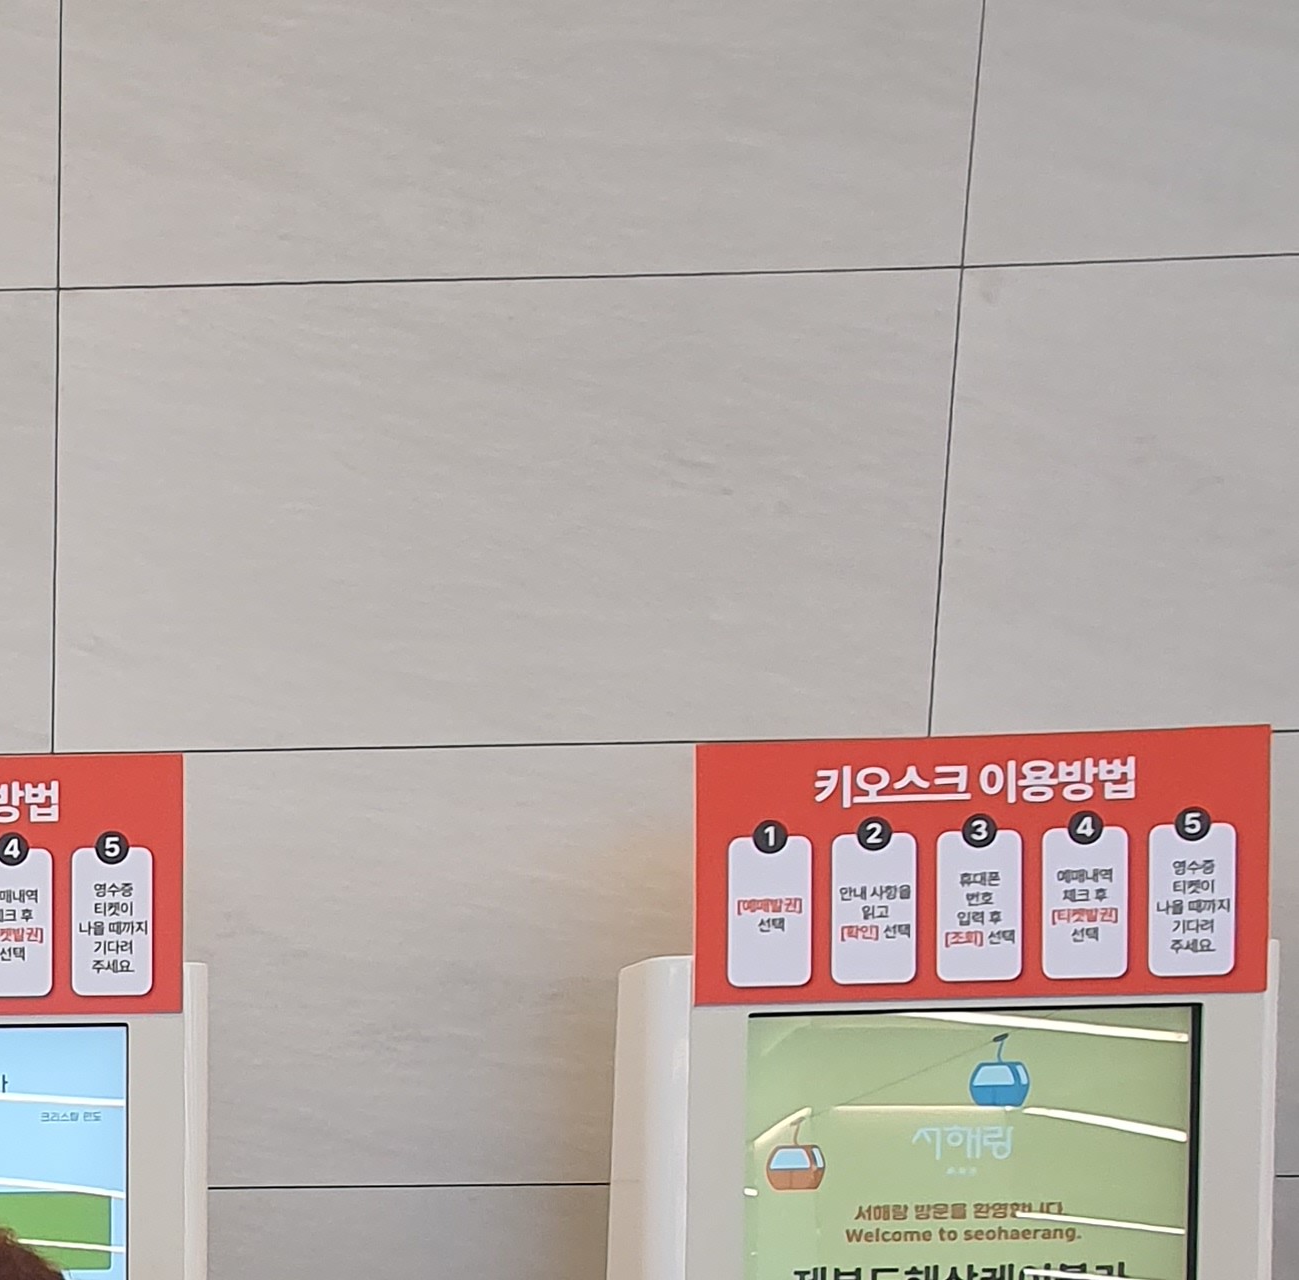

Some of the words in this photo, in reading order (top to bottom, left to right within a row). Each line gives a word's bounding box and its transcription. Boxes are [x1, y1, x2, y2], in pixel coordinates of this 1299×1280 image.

[813, 765, 972, 809] 키오스크
[978, 755, 1137, 804] 이용방법
[1172, 859, 1215, 876] 영수증
[93, 883, 134, 898] 영수증
[839, 885, 866, 901] 안내
[1062, 888, 1091, 902] 체크
[1094, 887, 1108, 902] 후
[1172, 879, 1215, 894] 티켓이
[965, 891, 994, 907] 번호
[21, 908, 34, 922] 후
[93, 902, 134, 917] 티켓이
[758, 917, 785, 932] 선택
[957, 911, 985, 926] 입력
[989, 910, 1002, 924] 후
[1172, 918, 1215, 934] 기다려
[78, 921, 105, 936] 나올
[108, 920, 148, 935] 때까지
[883, 923, 911, 939] 선택
[1071, 926, 1099, 943] 선택
[988, 929, 1015, 945] 선택
[0, 946, 26, 962] 선택
[93, 940, 134, 955] 기다려
[854, 1203, 909, 1222] 서해랑
[845, 1228, 933, 1244] Welcome
[938, 1228, 958, 1243] to
[963, 1226, 1083, 1244] seohaerang.
